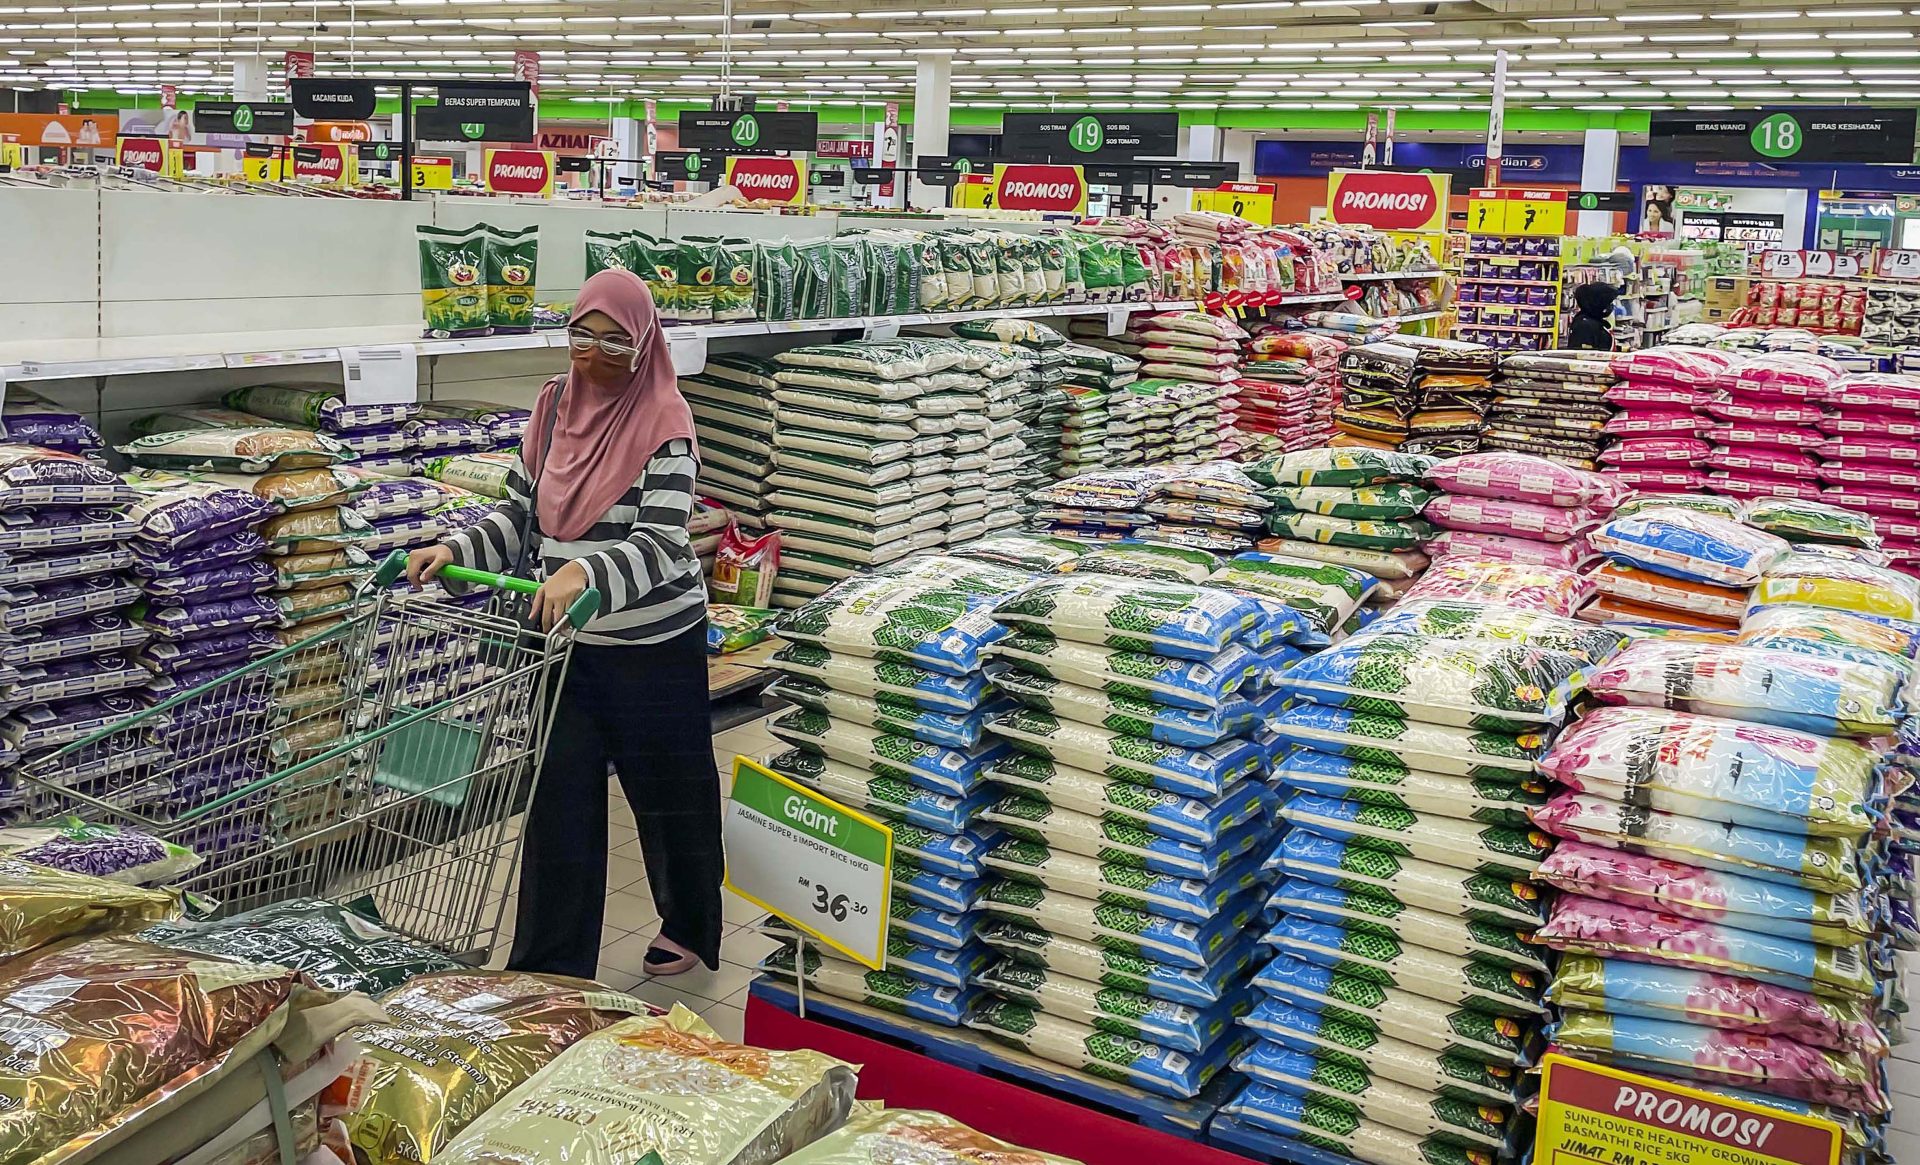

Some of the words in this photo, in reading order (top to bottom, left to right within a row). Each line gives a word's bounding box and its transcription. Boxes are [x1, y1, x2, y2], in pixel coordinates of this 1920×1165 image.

[312, 94, 336, 103] KACANG
[337, 94, 354, 103] KUDA
[444, 97, 465, 107] BERAS
[466, 98, 487, 107] SUPER
[487, 98, 520, 107] TEMPATAN
[235, 109, 252, 128] 22
[1811, 123, 1836, 131] BERAS
[735, 120, 755, 141] 20
[1075, 122, 1099, 146] 19
[1761, 121, 1795, 150] 18
[123, 150, 160, 164] PROMOSI
[377, 146, 388, 158] 12
[818, 142, 835, 153] KEDAI
[835, 142, 849, 153] JAM
[851, 144, 872, 157] T.H.
[258, 164, 268, 179] 6
[493, 164, 543, 180] PROMOSI
[687, 156, 699, 169] 11
[1472, 157, 1528, 169] gudian
[415, 171, 425, 186] 3
[736, 172, 793, 190] PROMOSI
[1005, 181, 1075, 200] PROMOSI
[1341, 190, 1428, 213] PROMOSI
[1586, 195, 1592, 207] 1
[1523, 209, 1536, 231] 7
[1777, 254, 1790, 266] 13
[1837, 258, 1847, 267] 3
[1897, 253, 1911, 265] 13
[784, 795, 839, 838] Giant
[736, 808, 767, 828] JASMINE
[768, 821, 792, 839] SUPER
[793, 835, 798, 843] 5
[798, 836, 828, 856] IMPORT
[830, 850, 847, 864] RICE
[849, 859, 869, 872] 10KG
[798, 876, 810, 888] RM
[812, 884, 850, 923] 36
[465, 1033, 492, 1055] Rice
[411, 1037, 440, 1052] 1121
[439, 1048, 488, 1086] (Steam)
[513, 1099, 597, 1127] CREAM
[1613, 1086, 1775, 1148] PROMOSI
[1564, 1110, 1643, 1139] SUNFLOWER
[1647, 1131, 1709, 1155] HEALTHY
[1711, 1148, 1779, 1165] GROWIN
[1564, 1123, 1630, 1148] BASMATHI
[1633, 1142, 1661, 1157] RICE
[1665, 1151, 1690, 1164] 5KG
[397, 1141, 419, 1162] 5KG
[1561, 1138, 1607, 1159] JIMAT
[1612, 1151, 1635, 1165] RM
